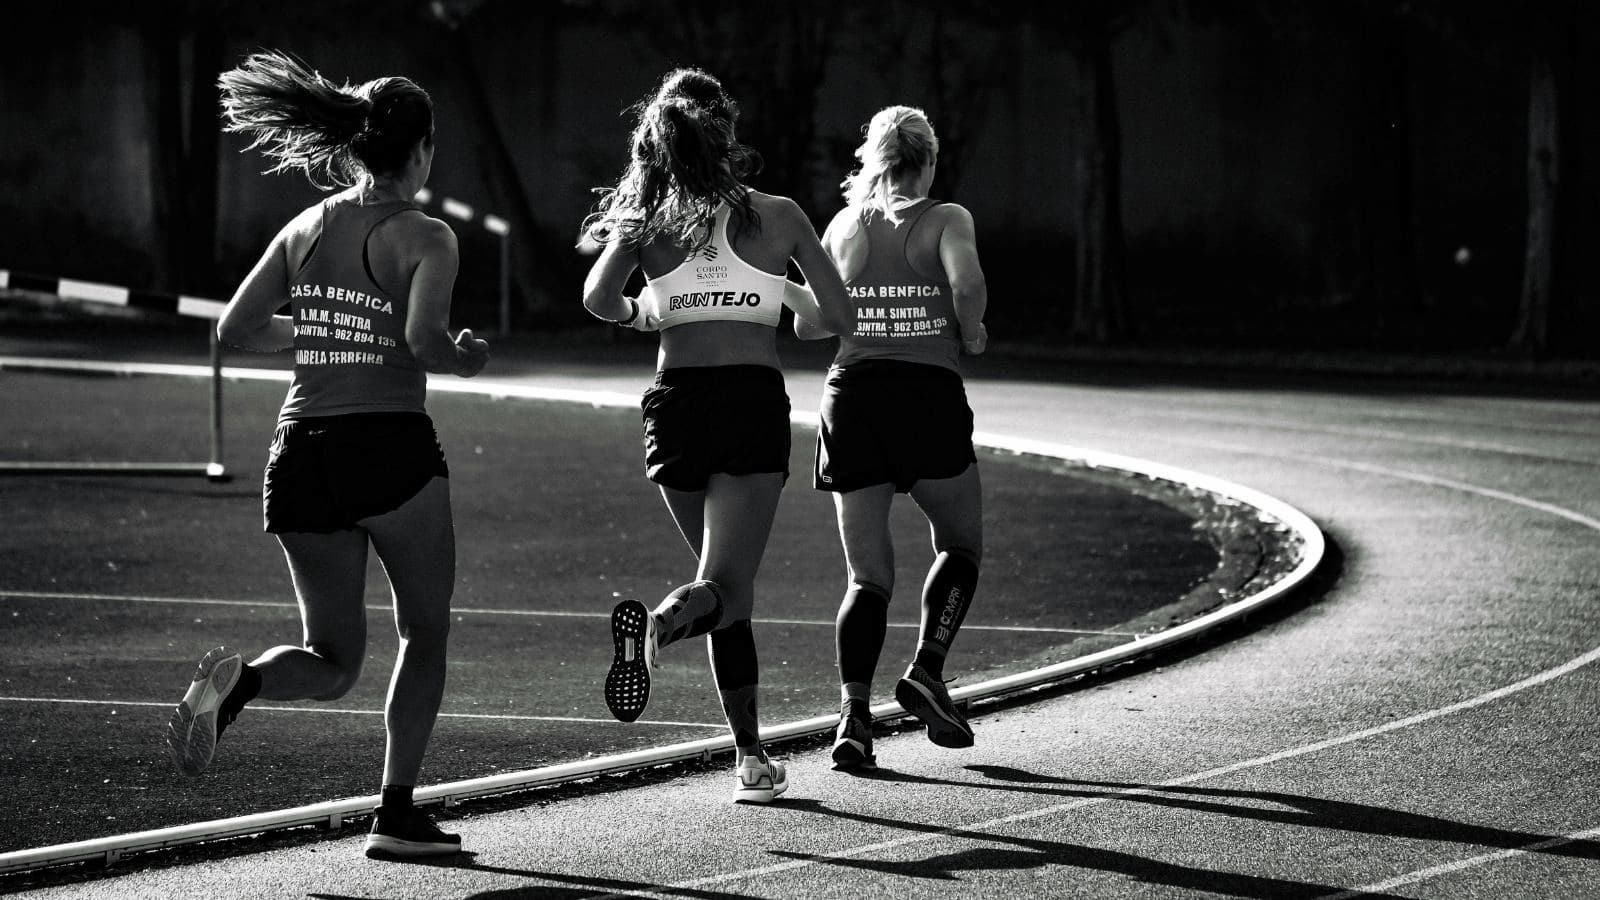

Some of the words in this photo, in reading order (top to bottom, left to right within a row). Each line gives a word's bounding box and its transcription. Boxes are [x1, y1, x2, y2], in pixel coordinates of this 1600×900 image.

[696, 265, 728, 273] CORPO
[696, 272, 728, 280] SANTO
[290, 284, 322, 298] CASA
[326, 286, 393, 315] BENFICA
[879, 285, 941, 298] BENFICA
[669, 291, 761, 311] RUNTEJO
[300, 308, 331, 324] A.M.M.
[333, 312, 372, 331] SINTRA
[857, 307, 888, 320] A.M.M.
[889, 306, 927, 319] SINTRA
[857, 321, 887, 332] SINTRA
[893, 322, 912, 332] 962
[913, 320, 932, 331] 894
[932, 316, 948, 329] 135
[299, 324, 328, 338] SINTRA
[334, 328, 353, 341] 962
[353, 331, 375, 344] 894
[377, 335, 397, 347] 135
